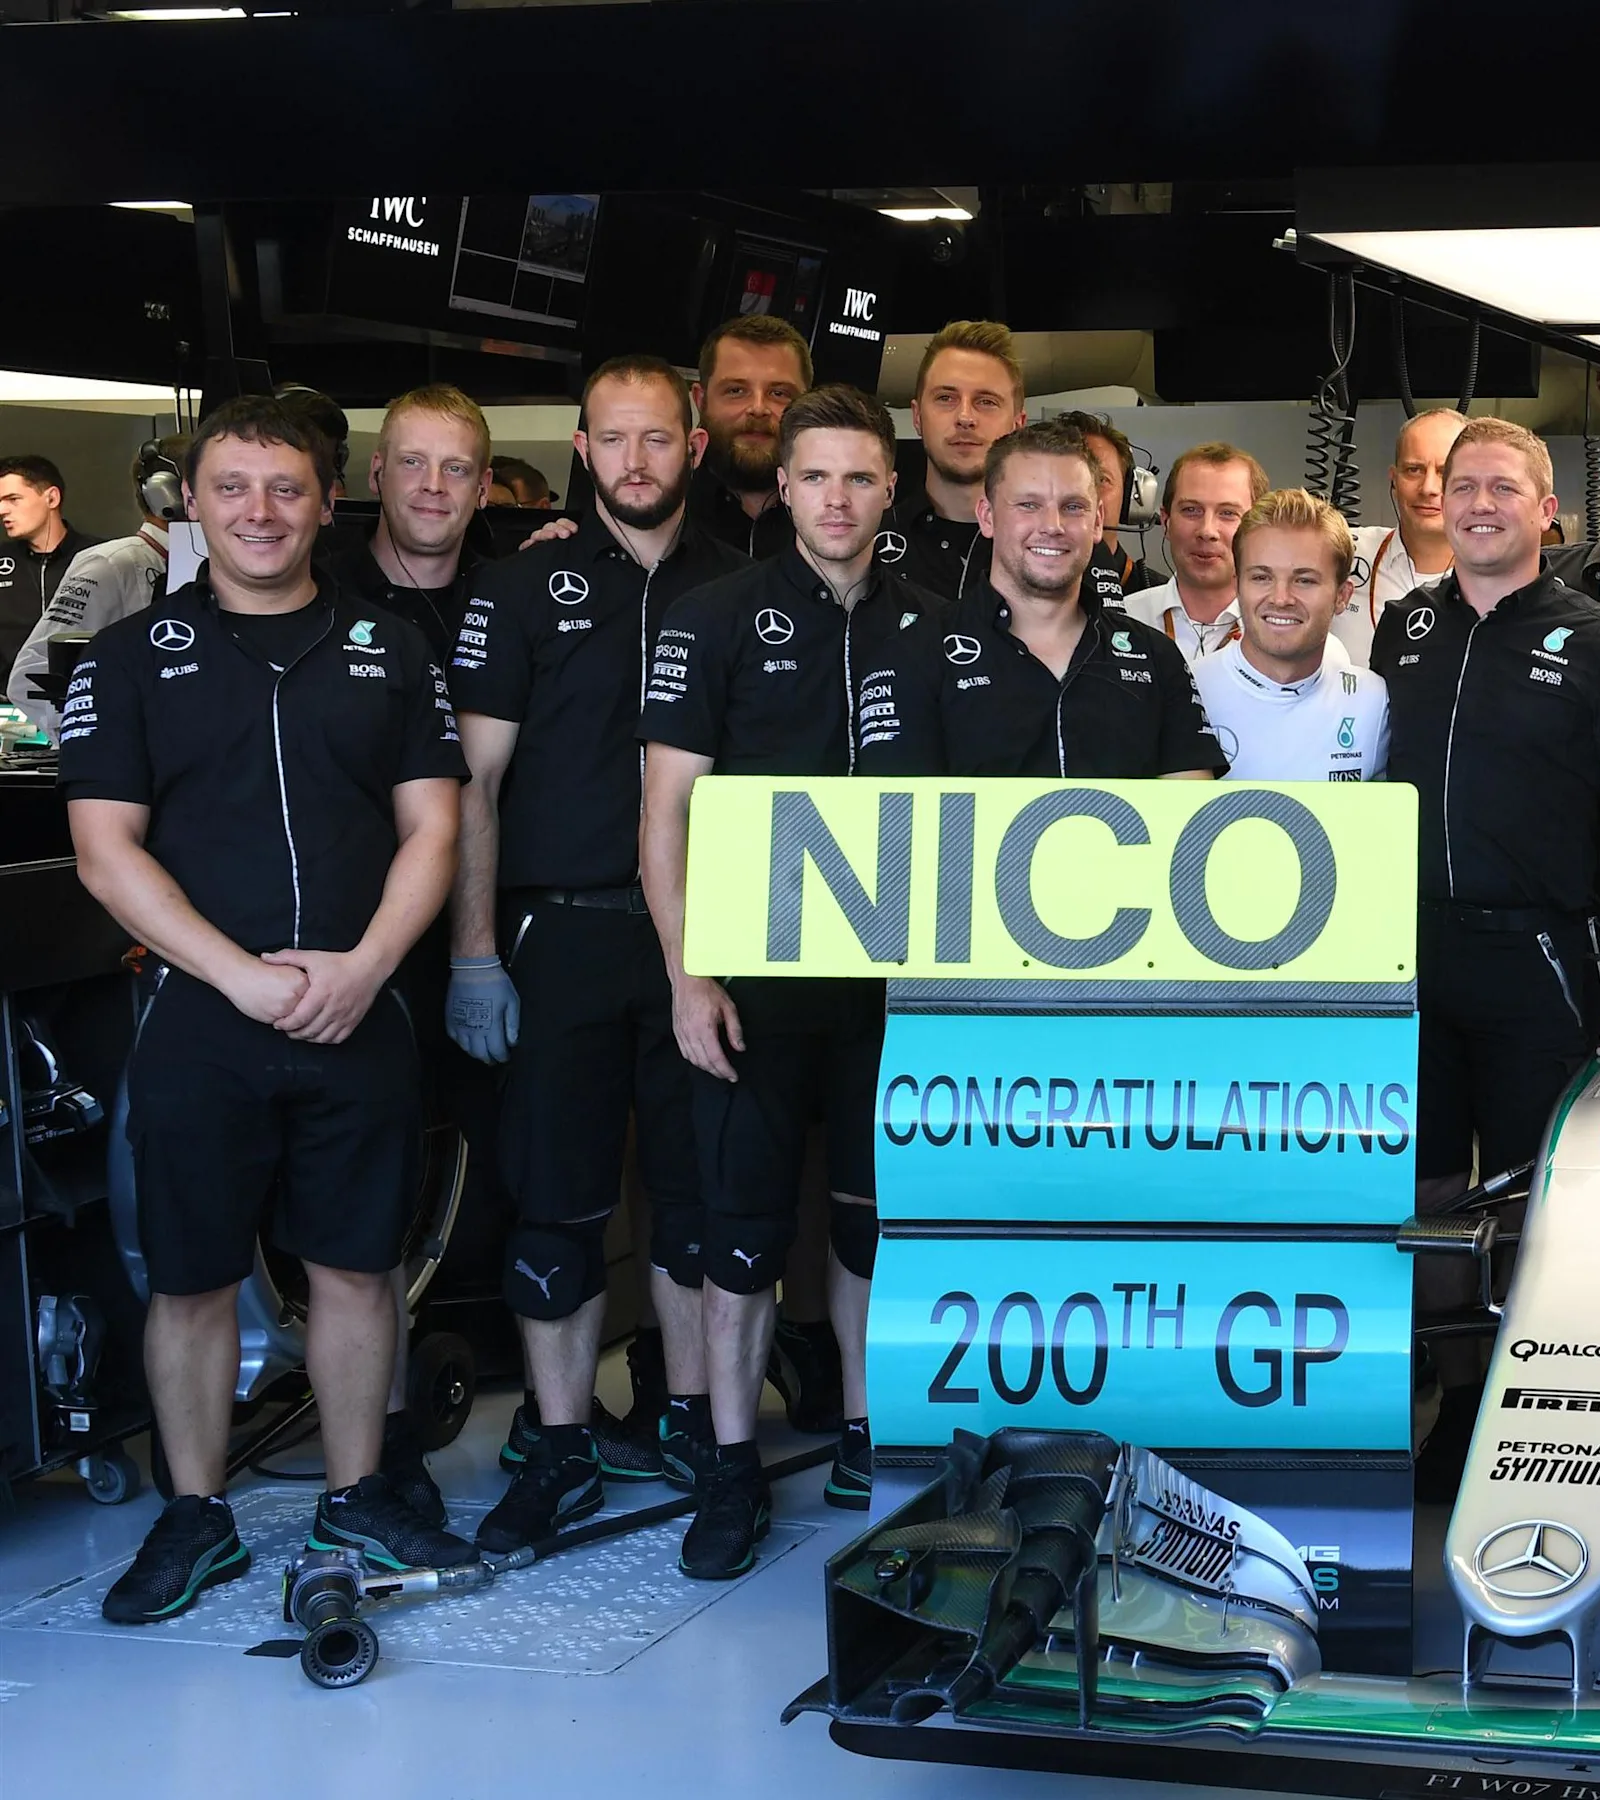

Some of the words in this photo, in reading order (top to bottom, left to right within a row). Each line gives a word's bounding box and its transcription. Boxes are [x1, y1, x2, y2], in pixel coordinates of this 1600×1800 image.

[370, 197, 426, 227] IWC
[347, 227, 439, 256] SCHAFFHAUSEN
[843, 288, 876, 321] IWC
[829, 322, 880, 341] SCHAFFHAUSEN
[1097, 582, 1123, 596] EPSO
[464, 612, 488, 628] SON
[571, 619, 593, 630] UBS
[776, 660, 798, 671] UBS
[1531, 649, 1569, 665] PETRONAS
[174, 663, 199, 676] UBS
[349, 664, 386, 675] BOSS
[1532, 667, 1563, 682] BOSS
[970, 676, 992, 687] UBS
[860, 685, 892, 706] PSON
[766, 787, 1337, 970] NICO
[882, 1074, 1410, 1156] CONGRATULATIONS
[1215, 1291, 1350, 1408] GP
[1156, 1489, 1241, 1541] PETRONAS
[1425, 1773, 1464, 1789] F1
[1479, 1777, 1551, 1796] W07
